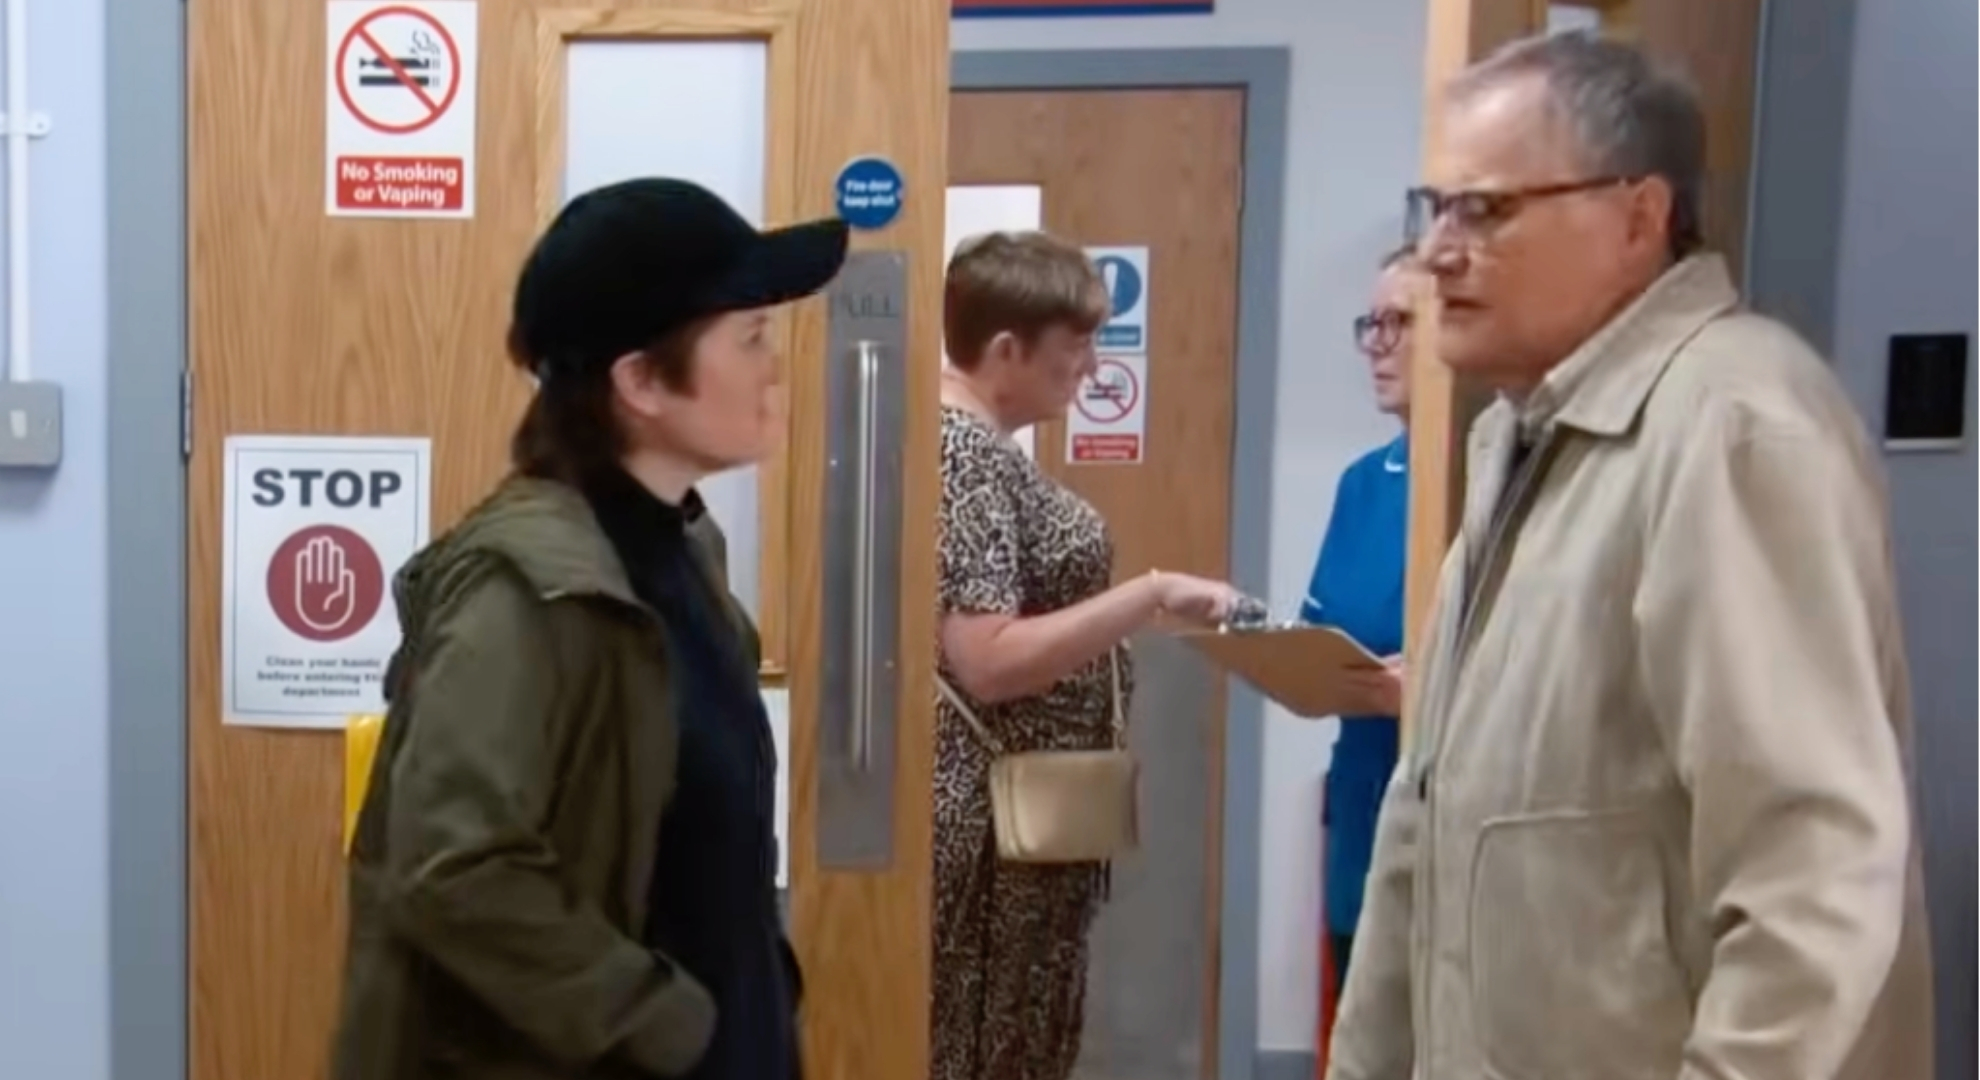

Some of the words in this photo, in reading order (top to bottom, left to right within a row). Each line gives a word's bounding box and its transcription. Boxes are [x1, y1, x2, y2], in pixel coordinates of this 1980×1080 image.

[342, 161, 370, 181] No
[373, 161, 458, 186] Smoking
[353, 186, 374, 202] or
[378, 184, 446, 208] Vaping
[252, 467, 402, 509] STOP
